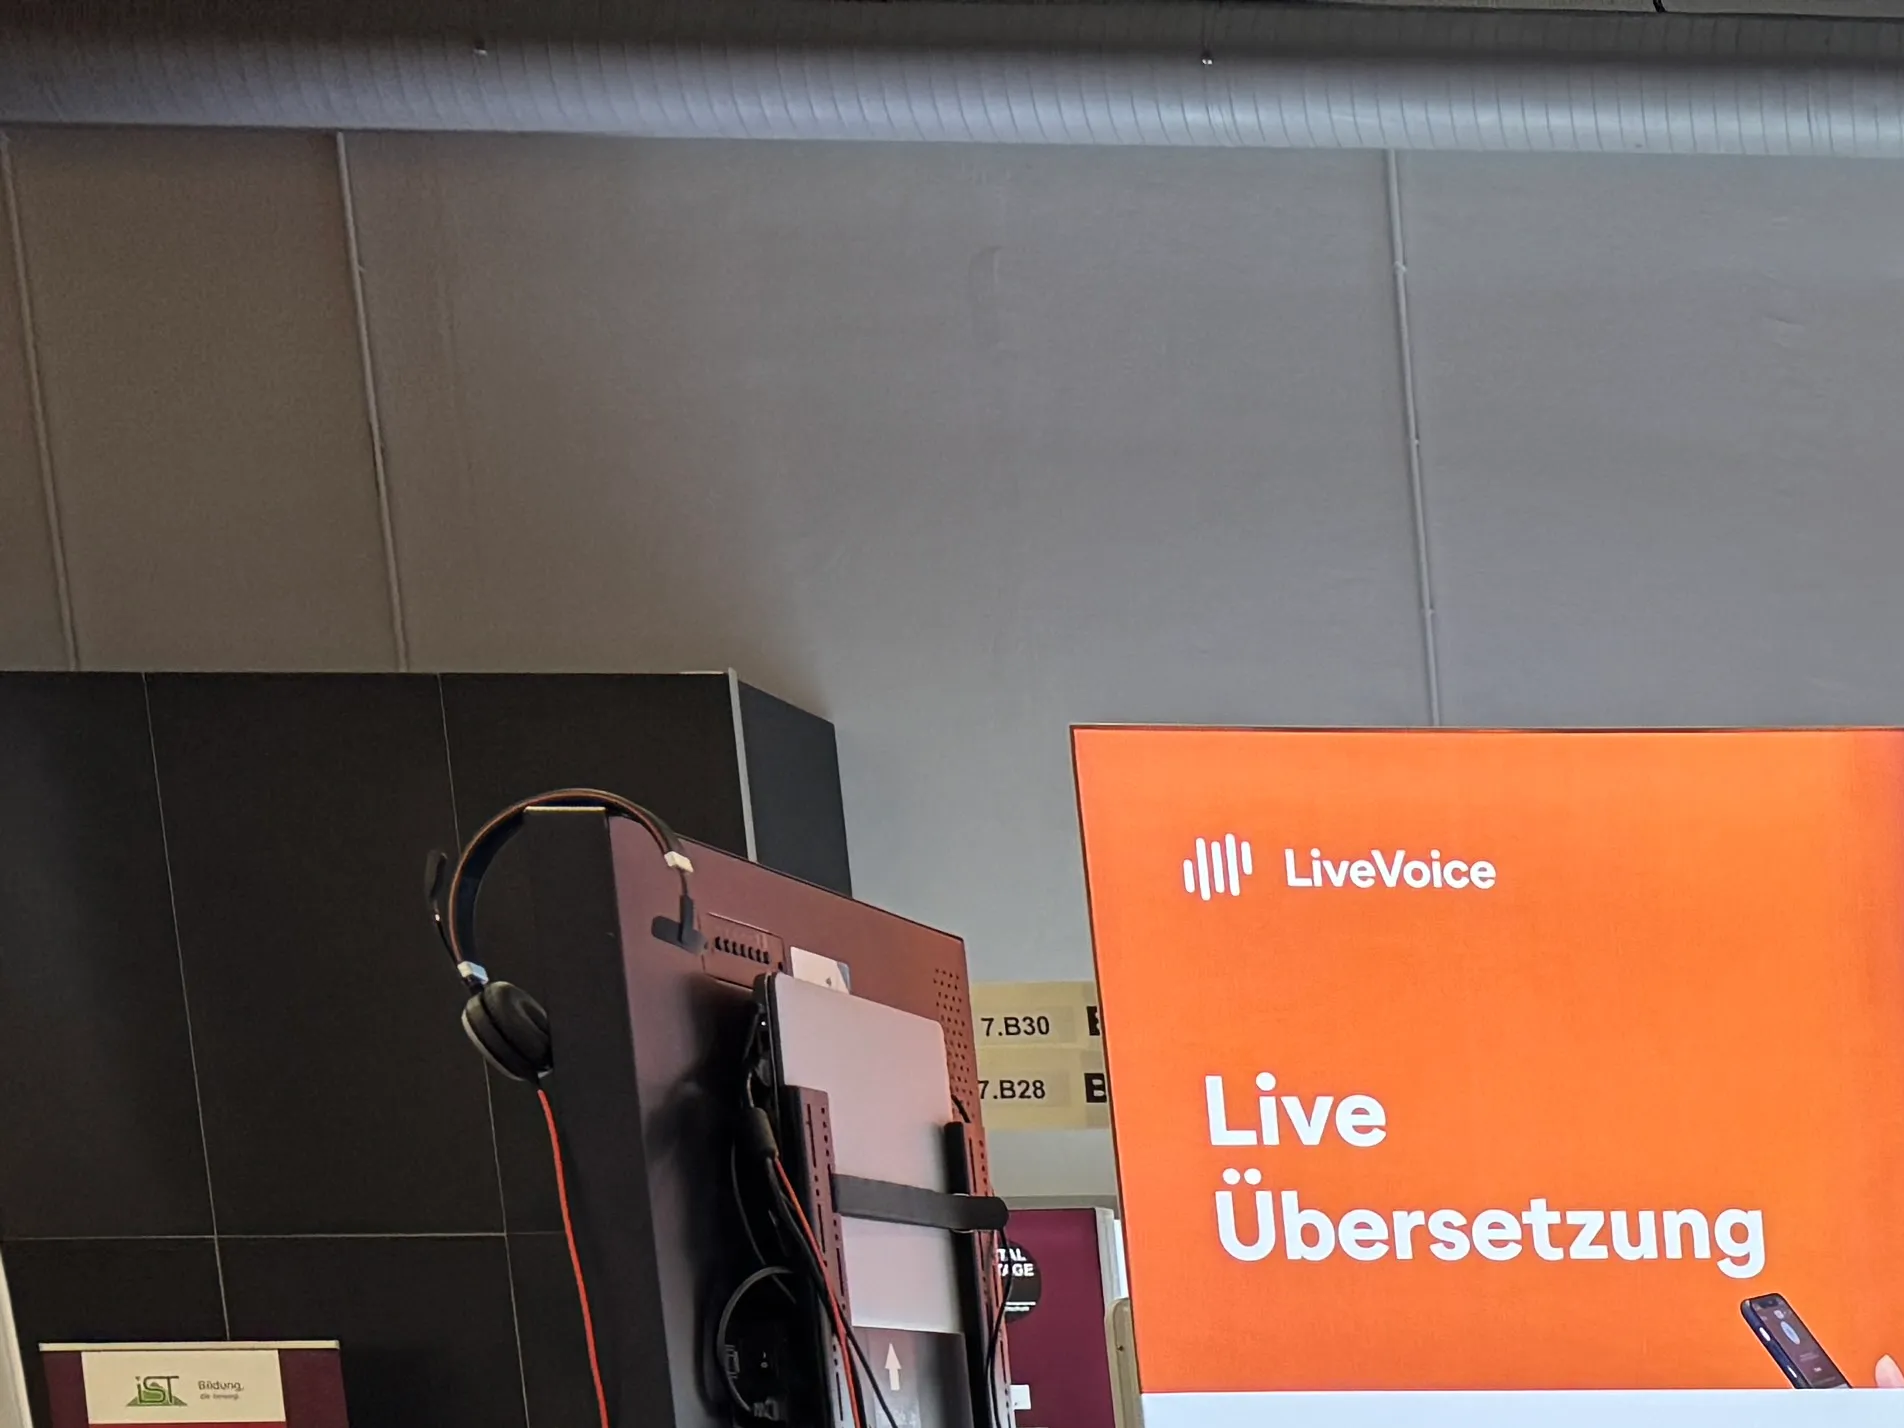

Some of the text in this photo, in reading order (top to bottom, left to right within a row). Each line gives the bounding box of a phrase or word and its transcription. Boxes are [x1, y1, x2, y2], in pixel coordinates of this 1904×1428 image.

[1284, 847, 1497, 889] LiveVoice
[981, 1016, 1050, 1037] 7.B30
[978, 1079, 1047, 1101] 7.B28
[1204, 1071, 1387, 1147] Live
[1214, 1166, 1767, 1279] Übersetzung
